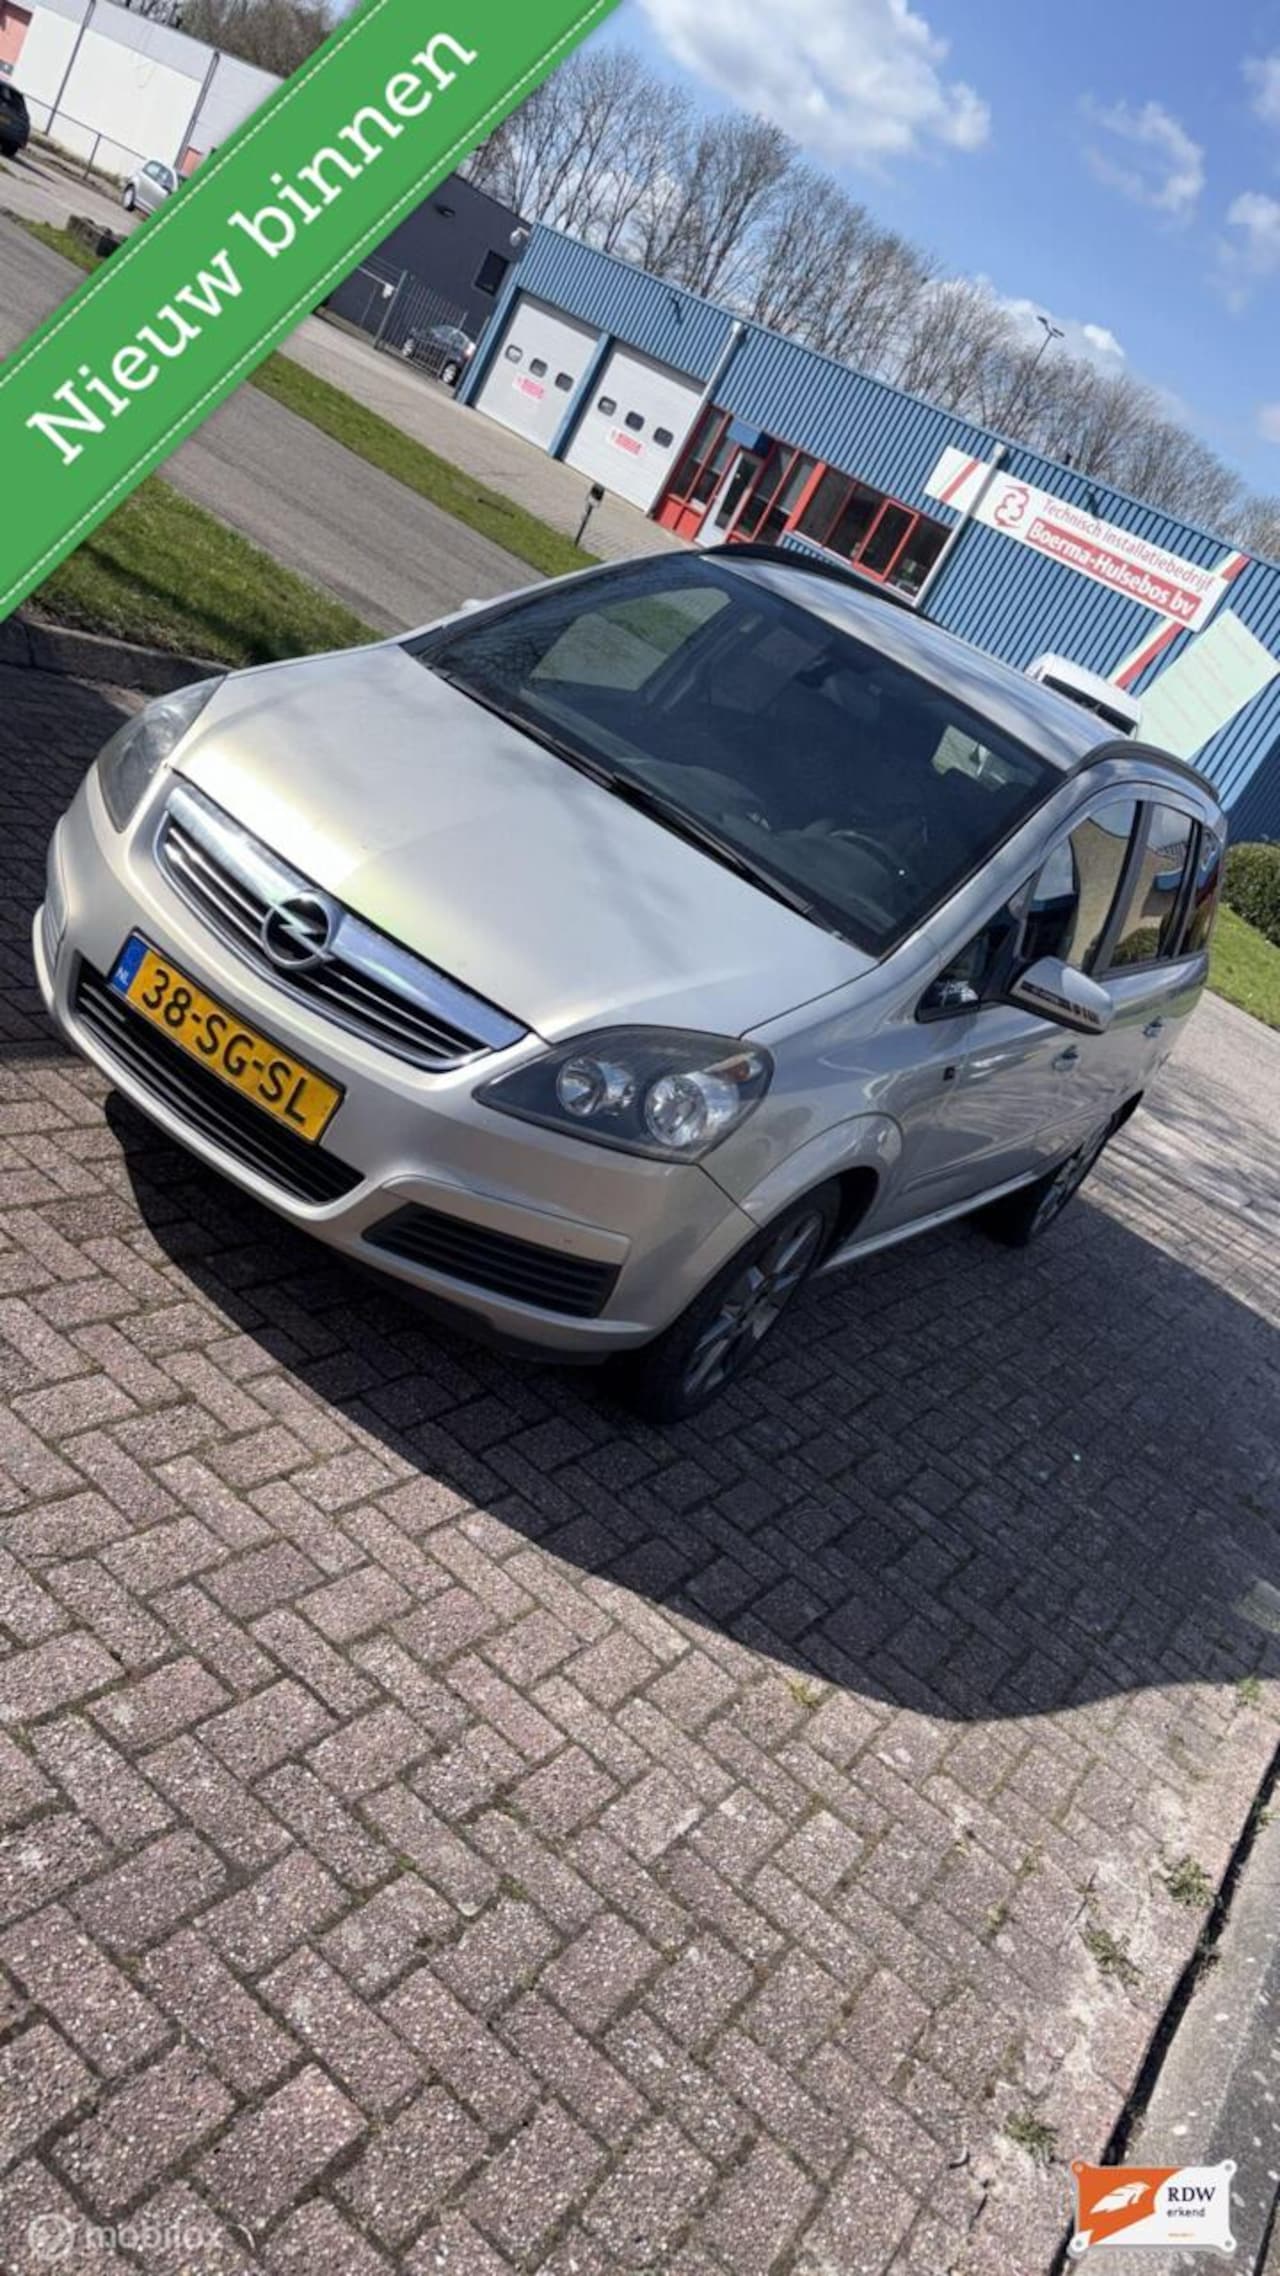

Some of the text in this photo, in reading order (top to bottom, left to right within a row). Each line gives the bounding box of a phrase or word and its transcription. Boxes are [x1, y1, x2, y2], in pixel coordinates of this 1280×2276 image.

[1042, 497, 1106, 540] Technisch
[1030, 524, 1199, 618] Boerma-Hulsebos bv
[116, 966, 130, 986] NL
[141, 968, 307, 1124] 38-SG-SL
